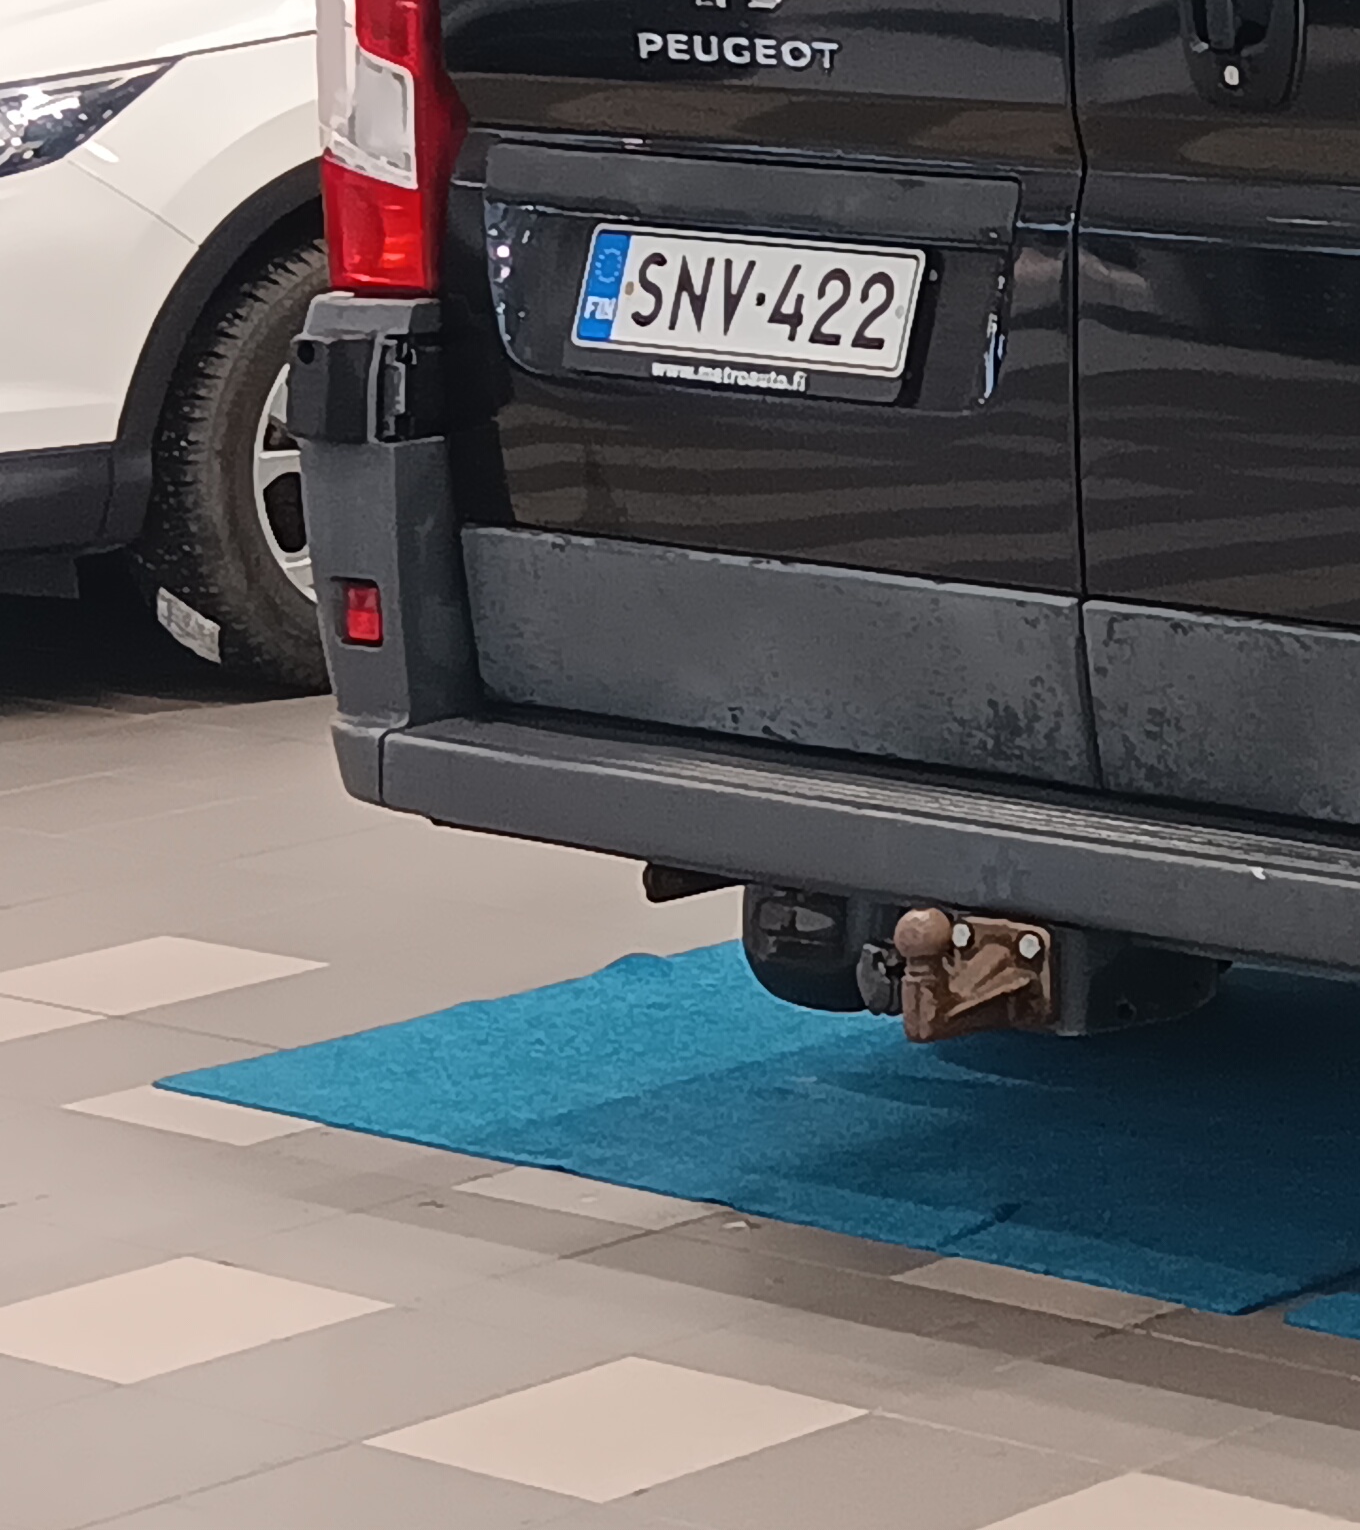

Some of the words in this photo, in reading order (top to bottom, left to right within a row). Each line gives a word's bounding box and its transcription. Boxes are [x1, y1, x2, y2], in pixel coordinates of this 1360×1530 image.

[637, 32, 839, 68] PEUGEOT
[583, 295, 616, 320] FIN
[631, 252, 895, 350] SNV-422
[652, 362, 807, 392] www.metroauto.fi
